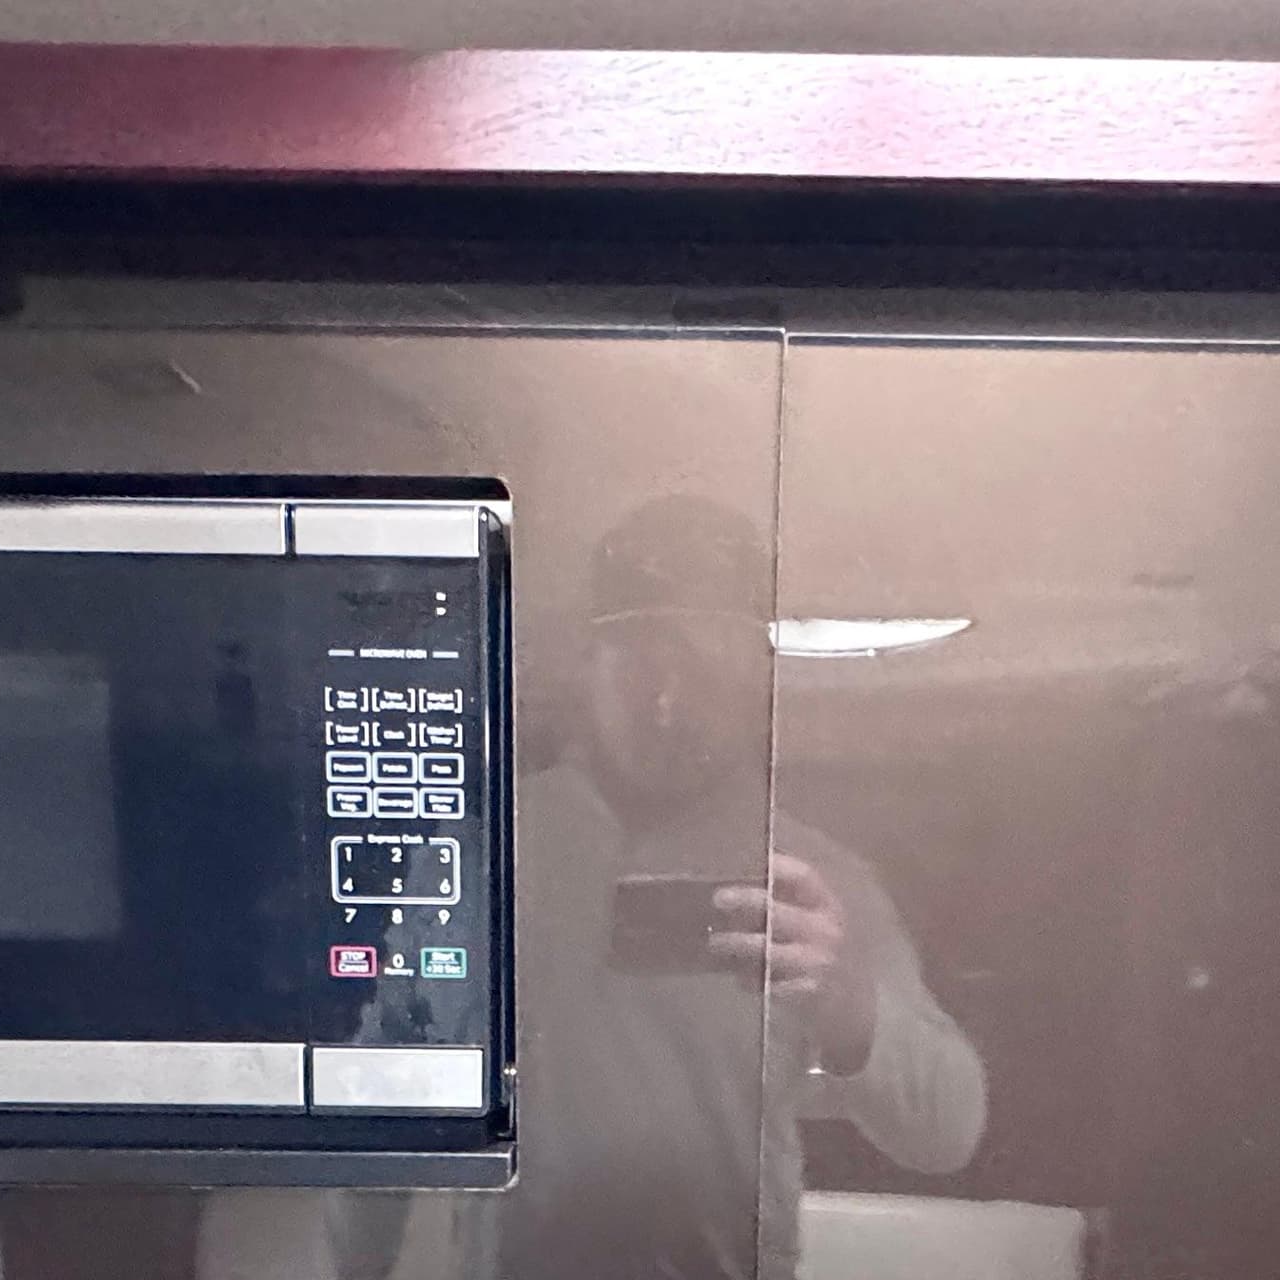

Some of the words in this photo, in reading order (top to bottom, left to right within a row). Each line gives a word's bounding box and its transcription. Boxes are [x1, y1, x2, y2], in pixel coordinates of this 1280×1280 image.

[344, 846, 353, 862] 1
[391, 846, 403, 863] 2
[439, 847, 451, 864] 3
[342, 877, 354, 892] 4
[391, 877, 403, 894] 5
[439, 878, 451, 894] 6
[344, 907, 357, 923] 7
[391, 908, 403, 924] 8
[438, 909, 451, 925] 9
[392, 953, 405, 969] 0
